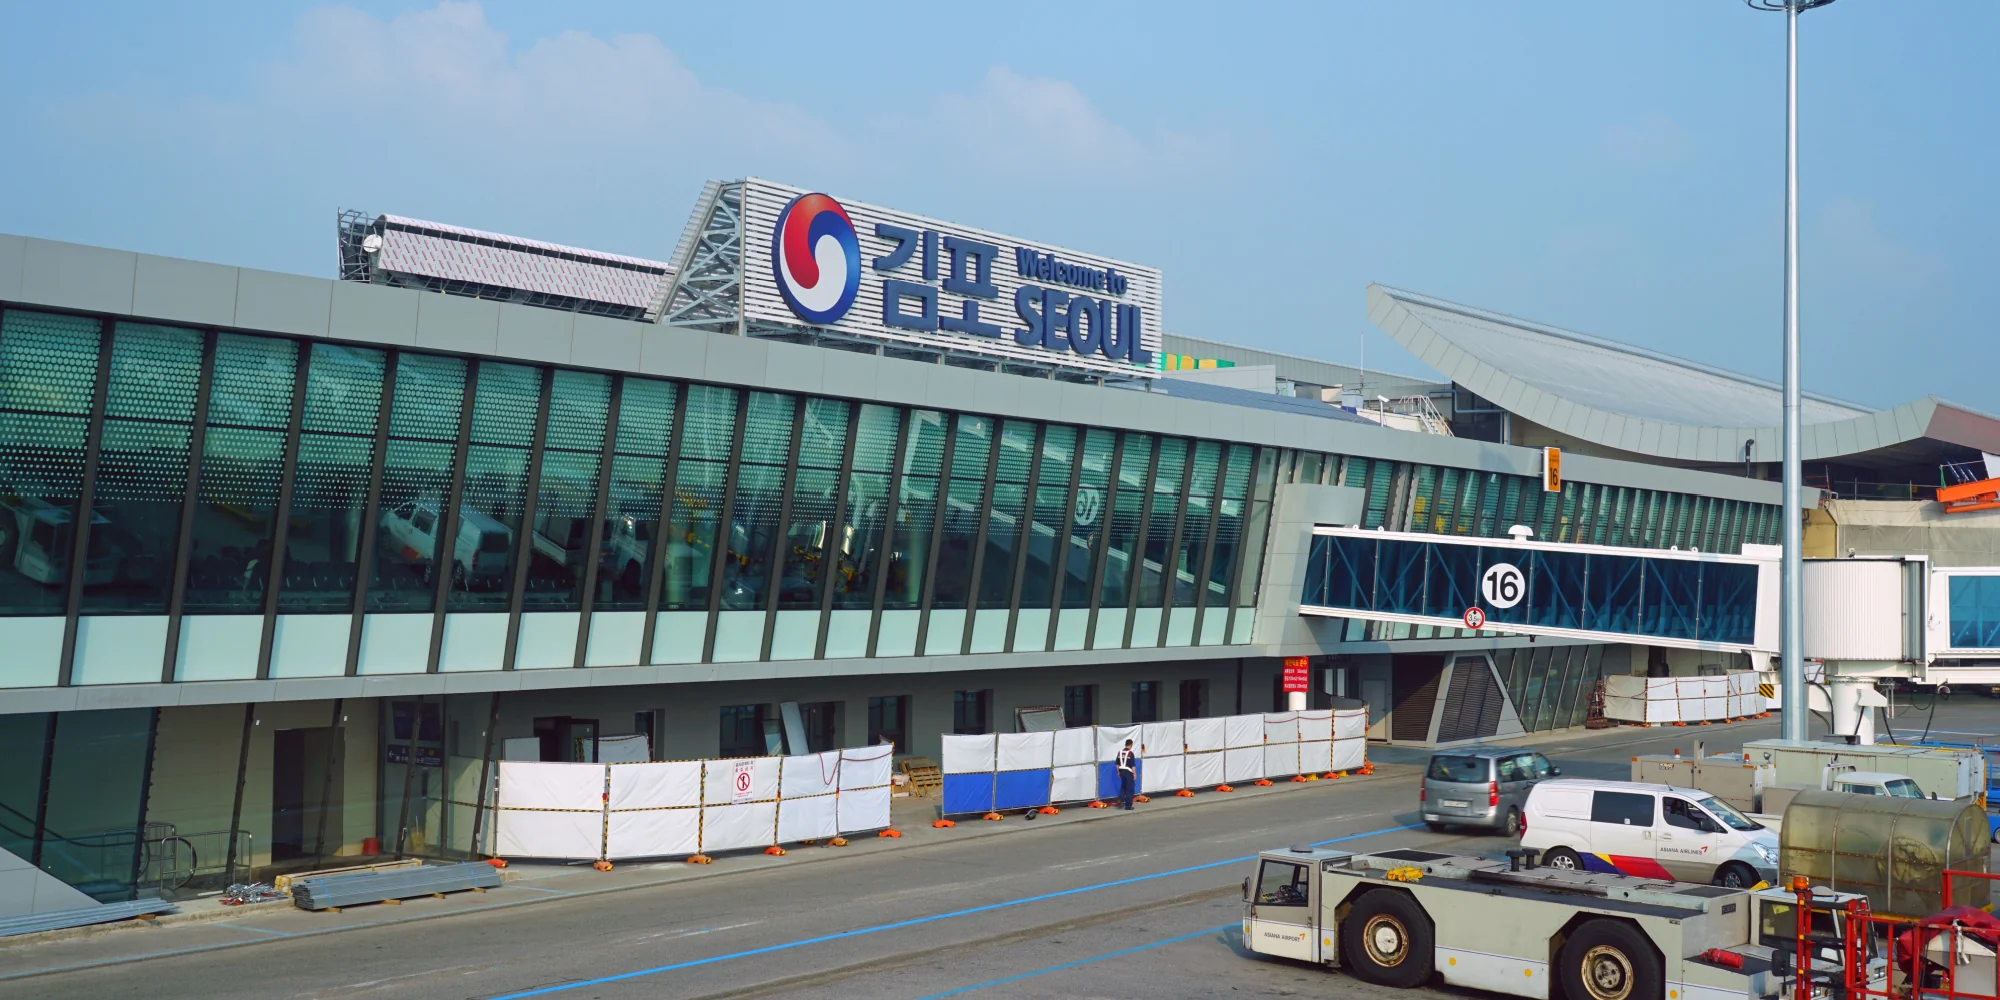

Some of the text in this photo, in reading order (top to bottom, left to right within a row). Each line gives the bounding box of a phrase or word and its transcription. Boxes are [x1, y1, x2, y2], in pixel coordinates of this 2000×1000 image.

[873, 223, 1001, 338] 김포
[1015, 246, 1128, 295] Welcome to
[1014, 285, 1152, 364] SEOUL
[1549, 467, 1558, 486] 16
[1487, 571, 1518, 601] 16
[1680, 848, 1703, 856] AIRLINES
[1264, 931, 1301, 942] ASIANA AIRPORT
